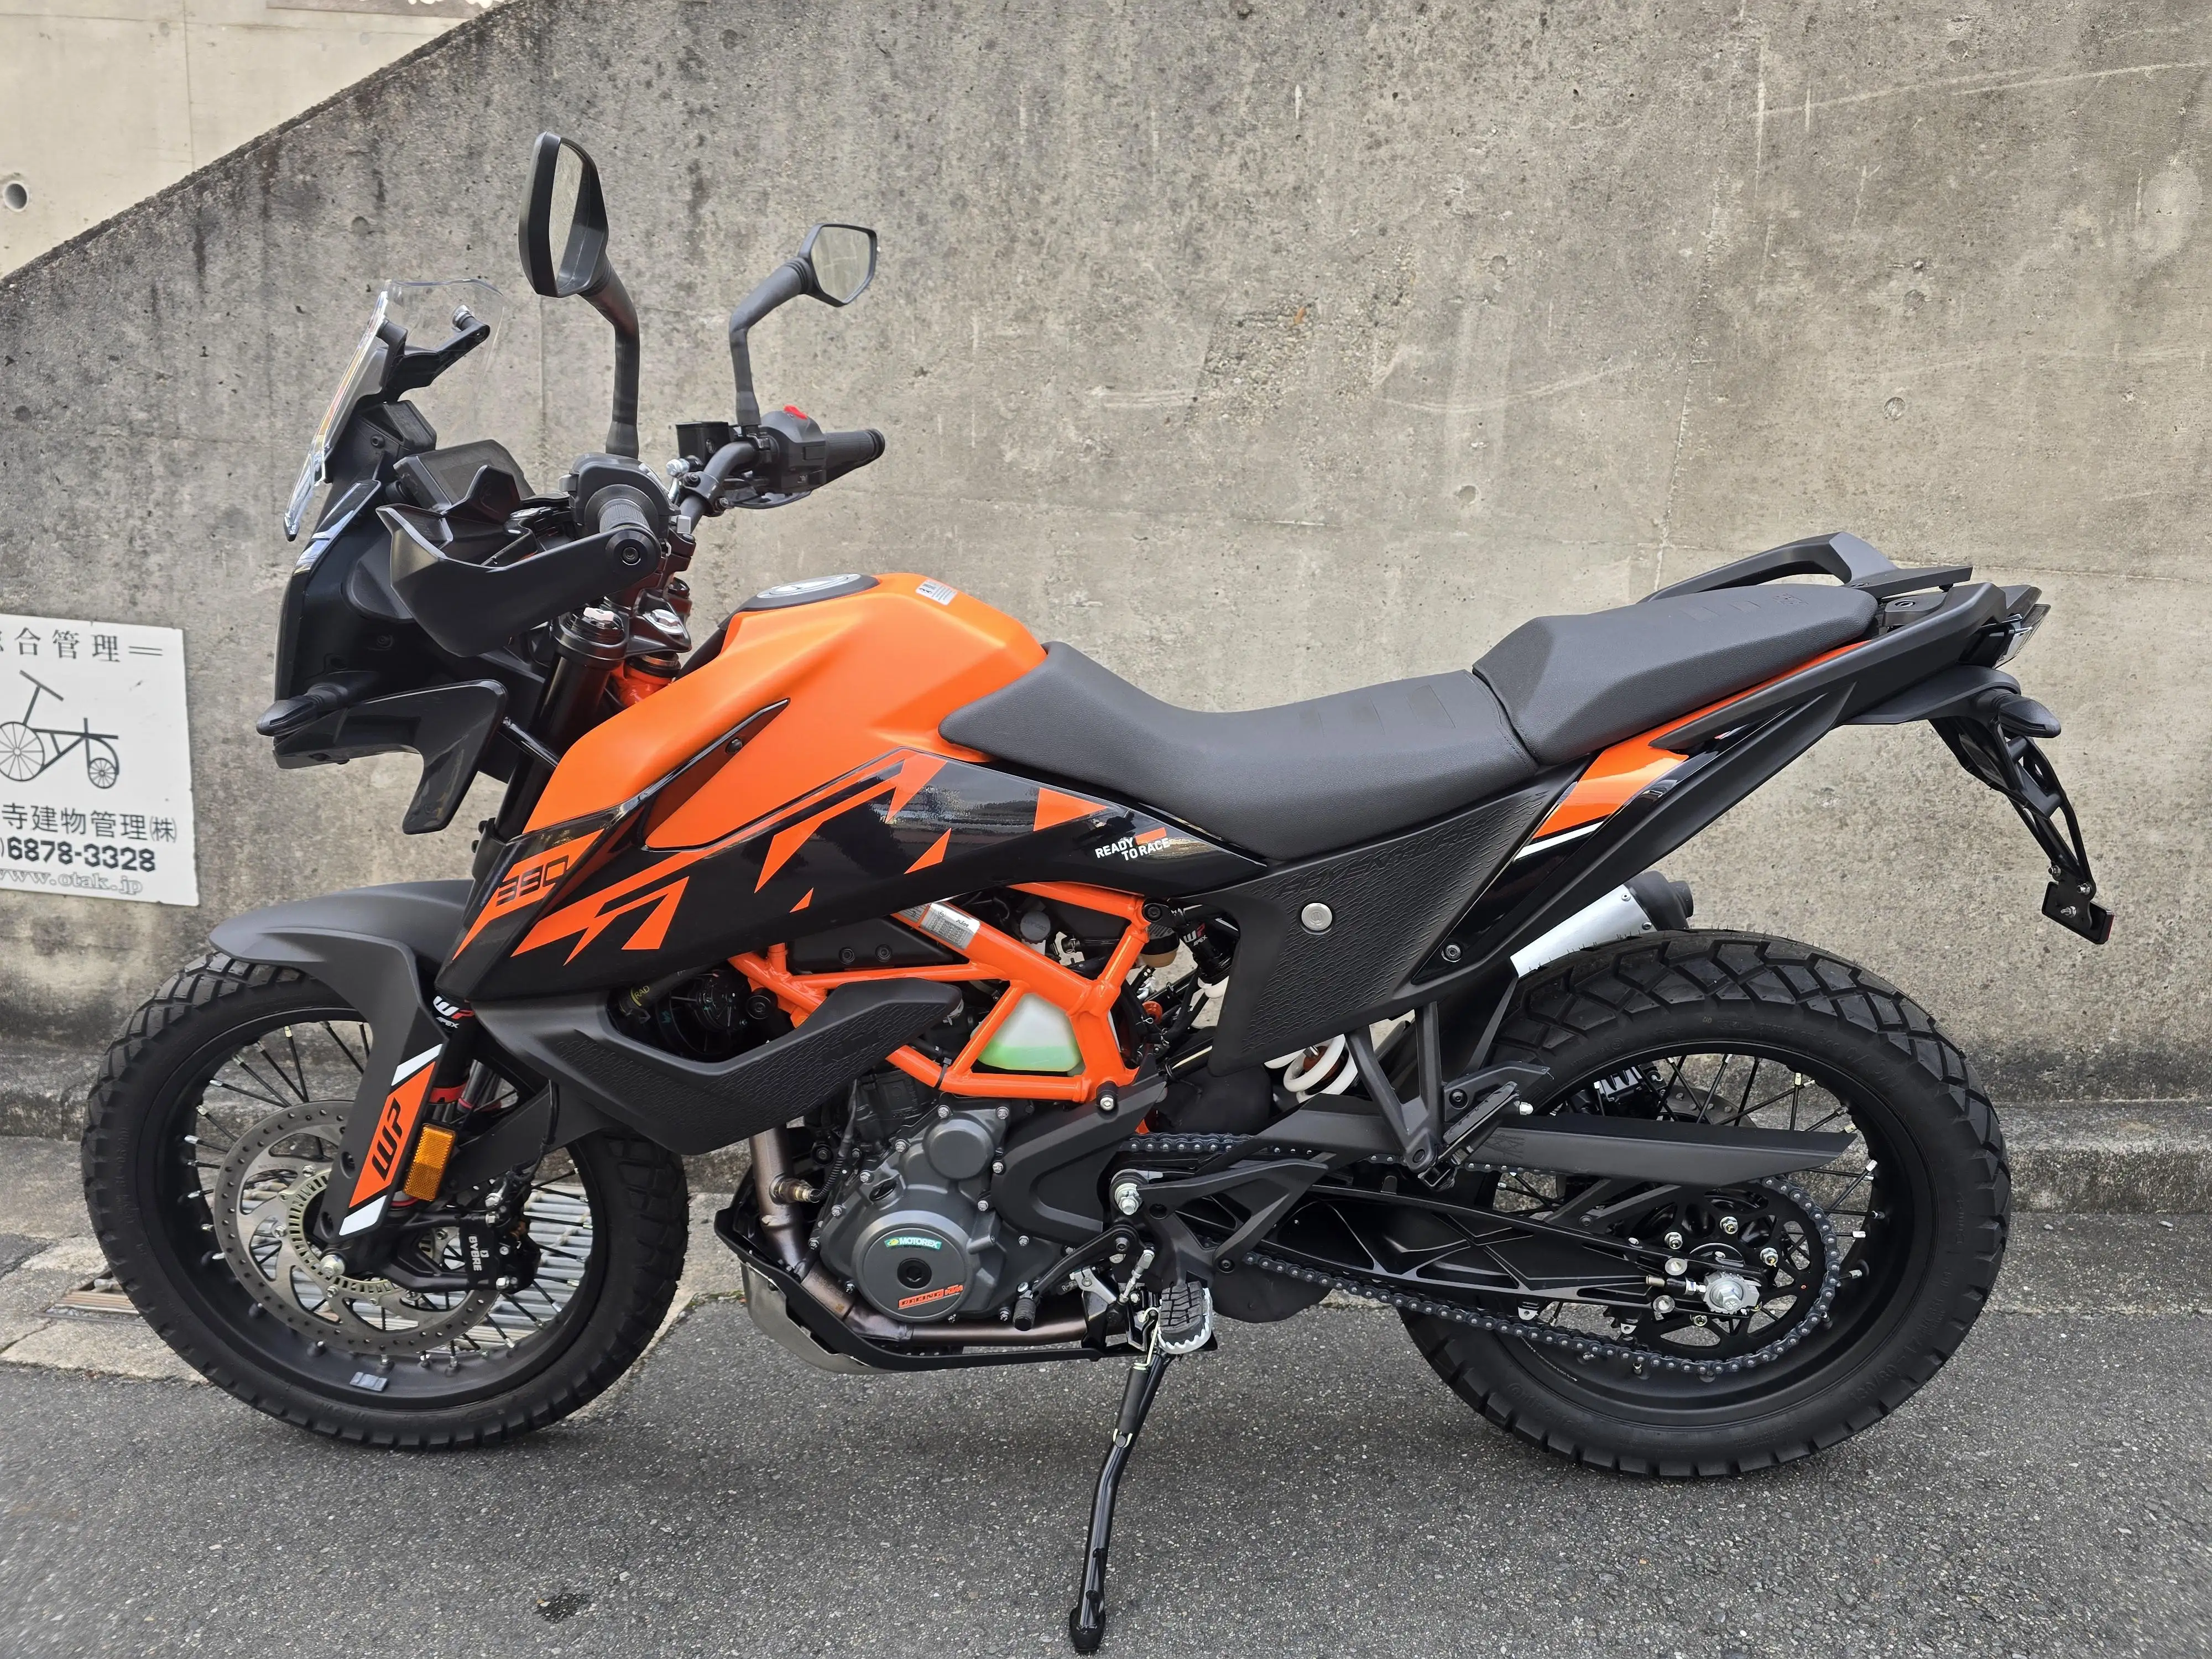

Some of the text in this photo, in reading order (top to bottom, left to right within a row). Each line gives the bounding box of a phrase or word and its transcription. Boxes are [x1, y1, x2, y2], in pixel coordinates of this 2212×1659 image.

[1095, 837, 1134, 858] READY
[1121, 837, 1171, 861] TO RACE
[1183, 922, 1206, 943] WP
[634, 985, 650, 1000] RAD
[432, 995, 474, 1020] WP
[435, 1016, 460, 1029] APEX
[372, 1097, 403, 1182] WP
[468, 1236, 482, 1271] BYBRE
[899, 1237, 939, 1249] MOTOREX
